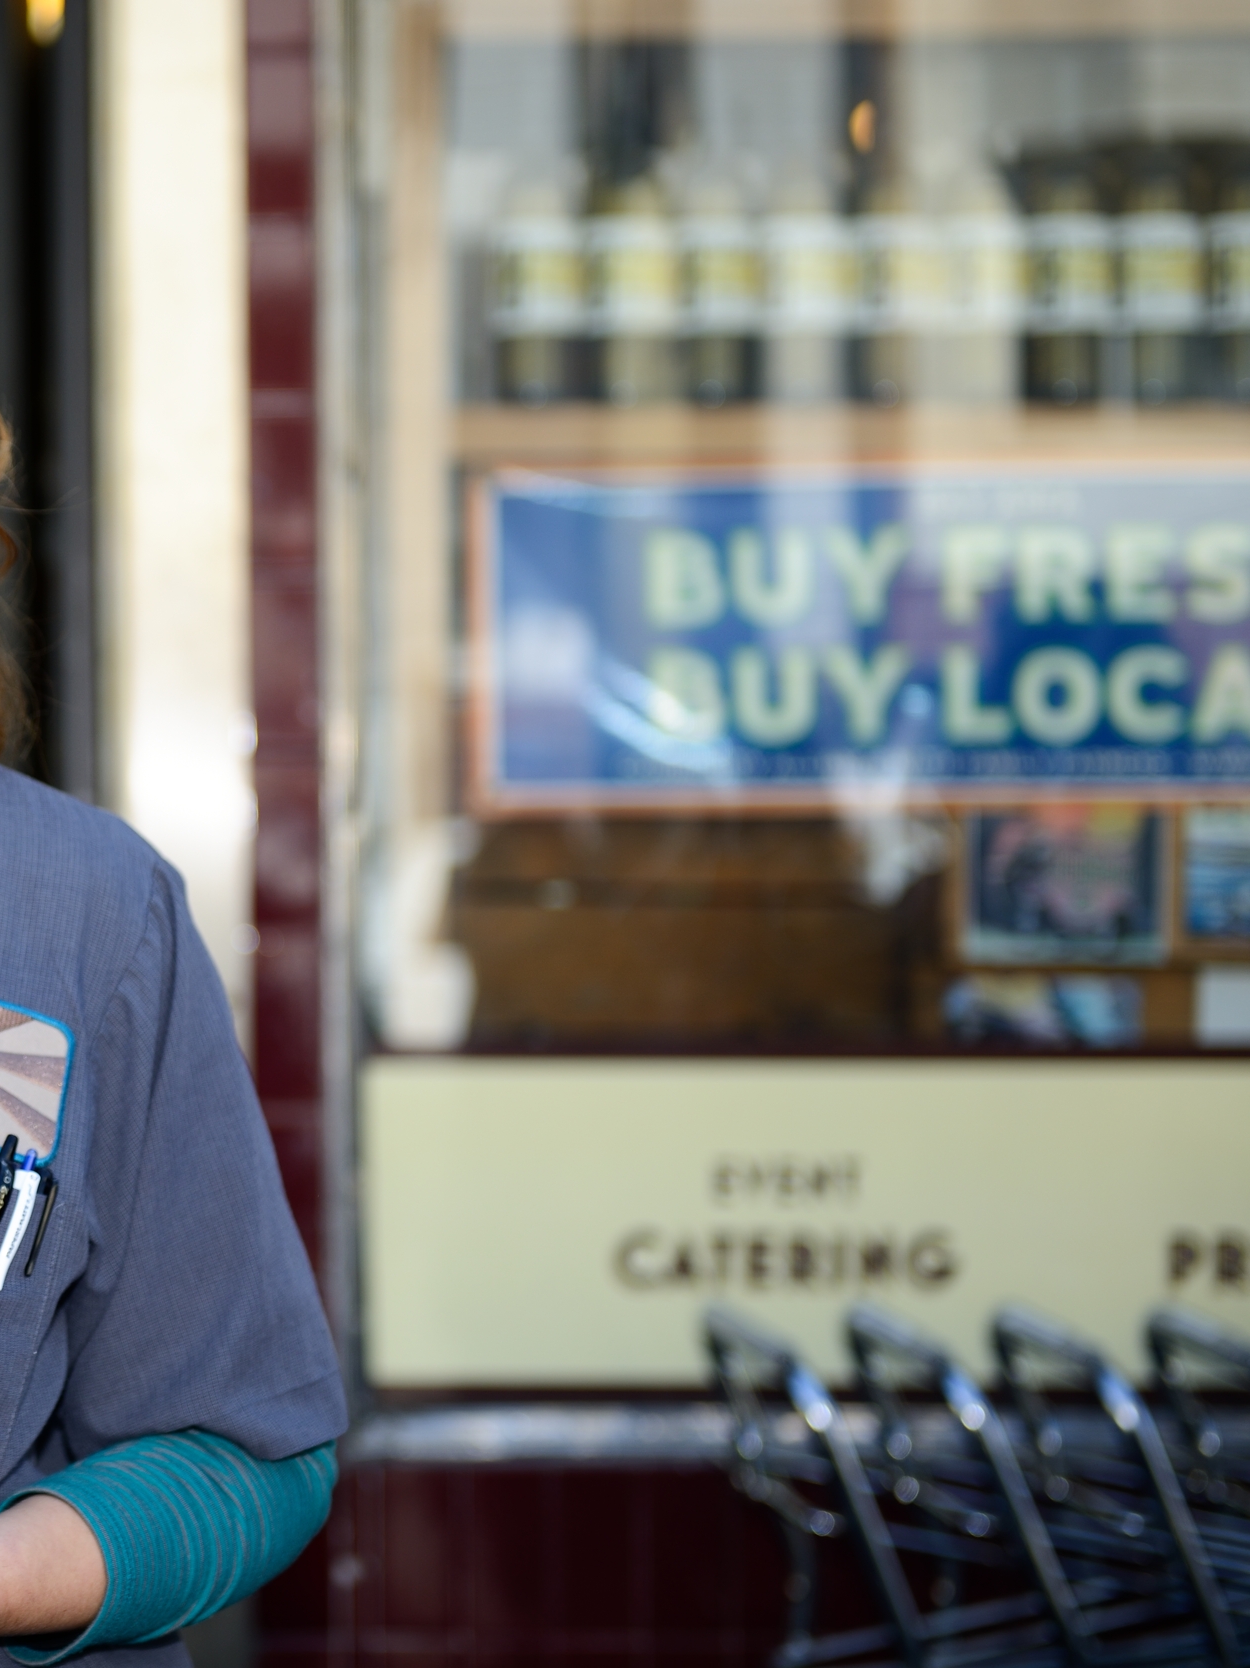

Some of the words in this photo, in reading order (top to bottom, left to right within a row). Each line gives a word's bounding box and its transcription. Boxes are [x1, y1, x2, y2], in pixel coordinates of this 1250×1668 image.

[644, 526, 908, 628] BUY
[646, 646, 908, 746] BUY
[710, 1156, 862, 1206] EVENT
[614, 1228, 958, 1291] CATERING
